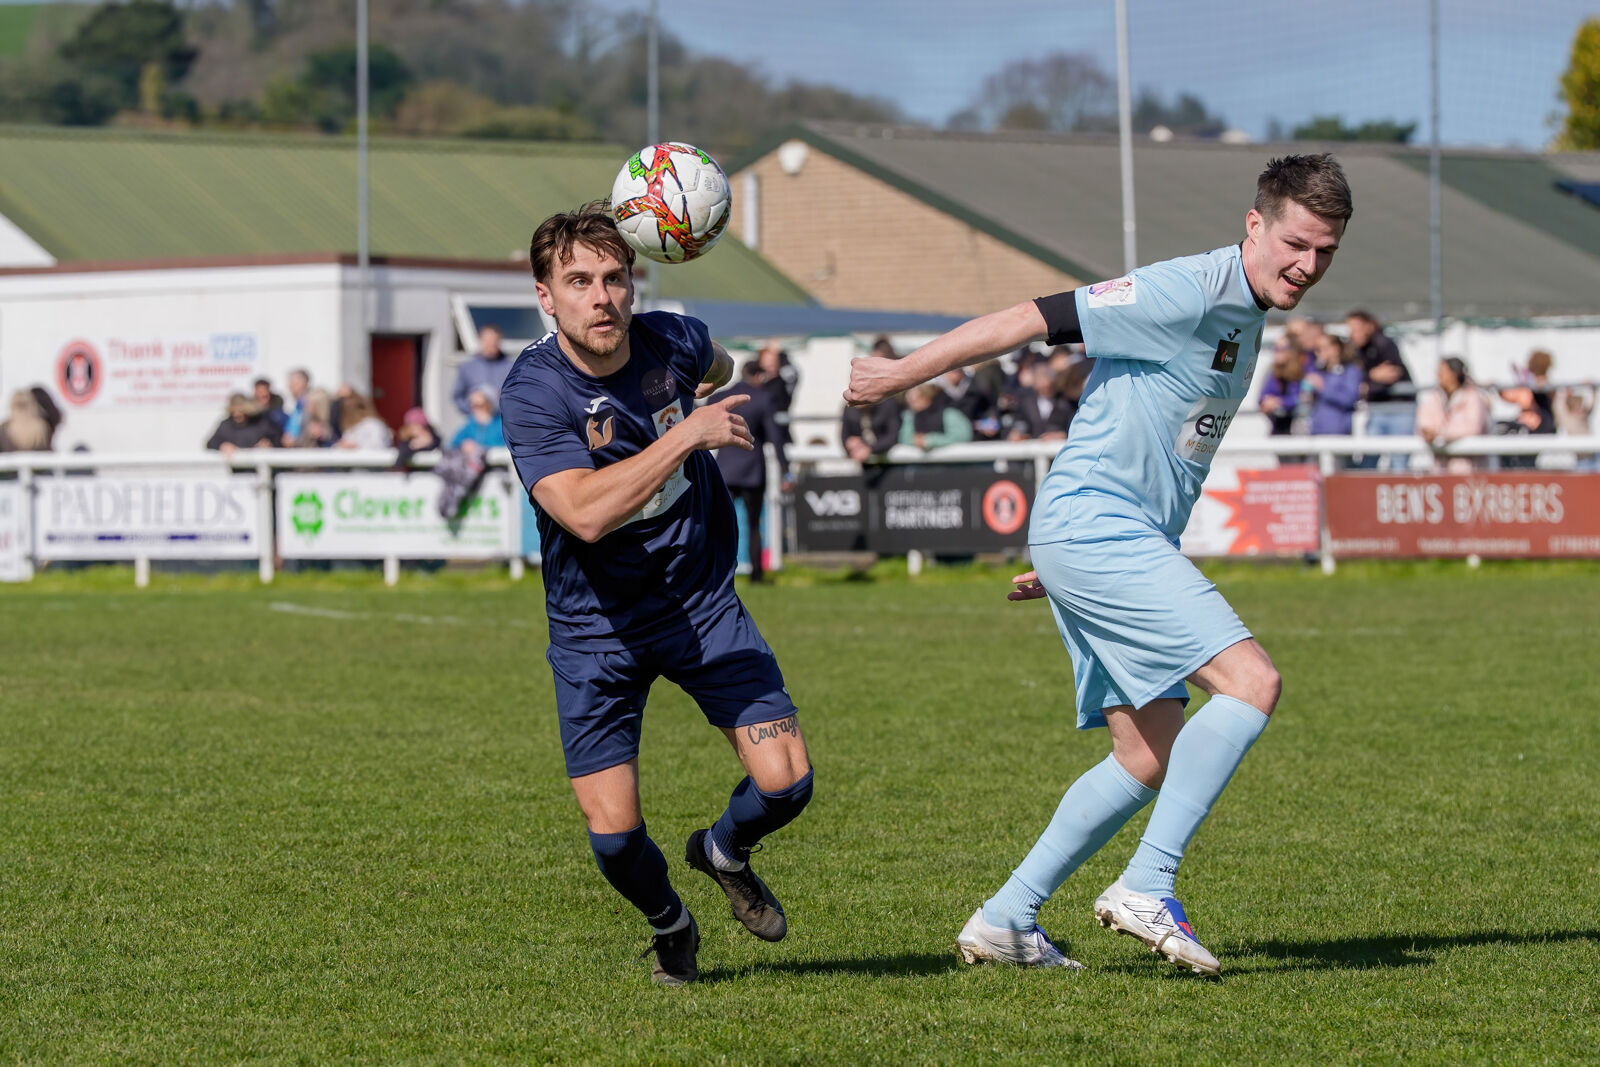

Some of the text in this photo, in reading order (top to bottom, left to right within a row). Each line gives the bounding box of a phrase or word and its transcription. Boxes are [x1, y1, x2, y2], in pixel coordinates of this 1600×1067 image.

[51, 480, 247, 526] PADFIELDS
[333, 489, 424, 519] Clover
[886, 506, 963, 529] PARTNER
